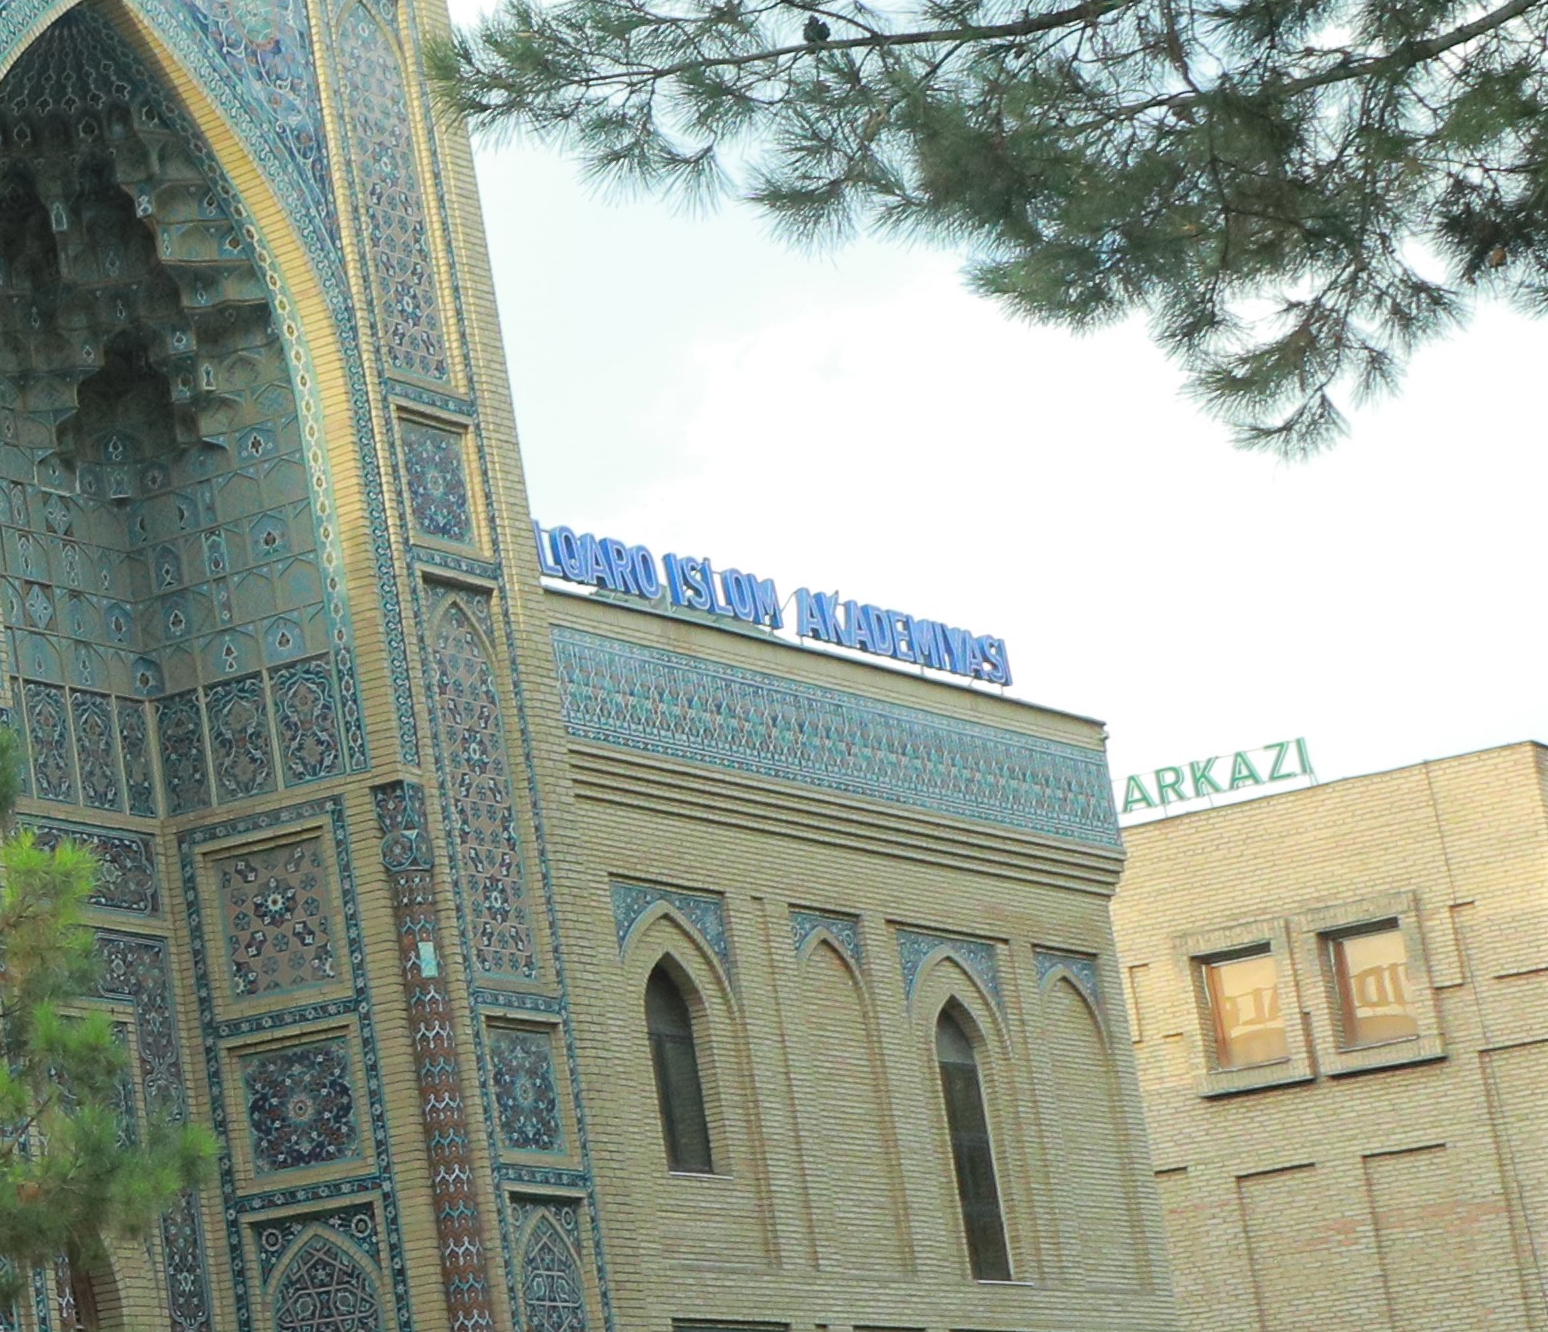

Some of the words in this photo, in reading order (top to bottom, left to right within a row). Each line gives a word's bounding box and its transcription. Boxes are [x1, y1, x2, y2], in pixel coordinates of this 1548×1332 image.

[661, 552, 785, 630] ISLOM
[795, 586, 1014, 687] AKADEMIYASI
[1122, 736, 1314, 814] ARKAZI
